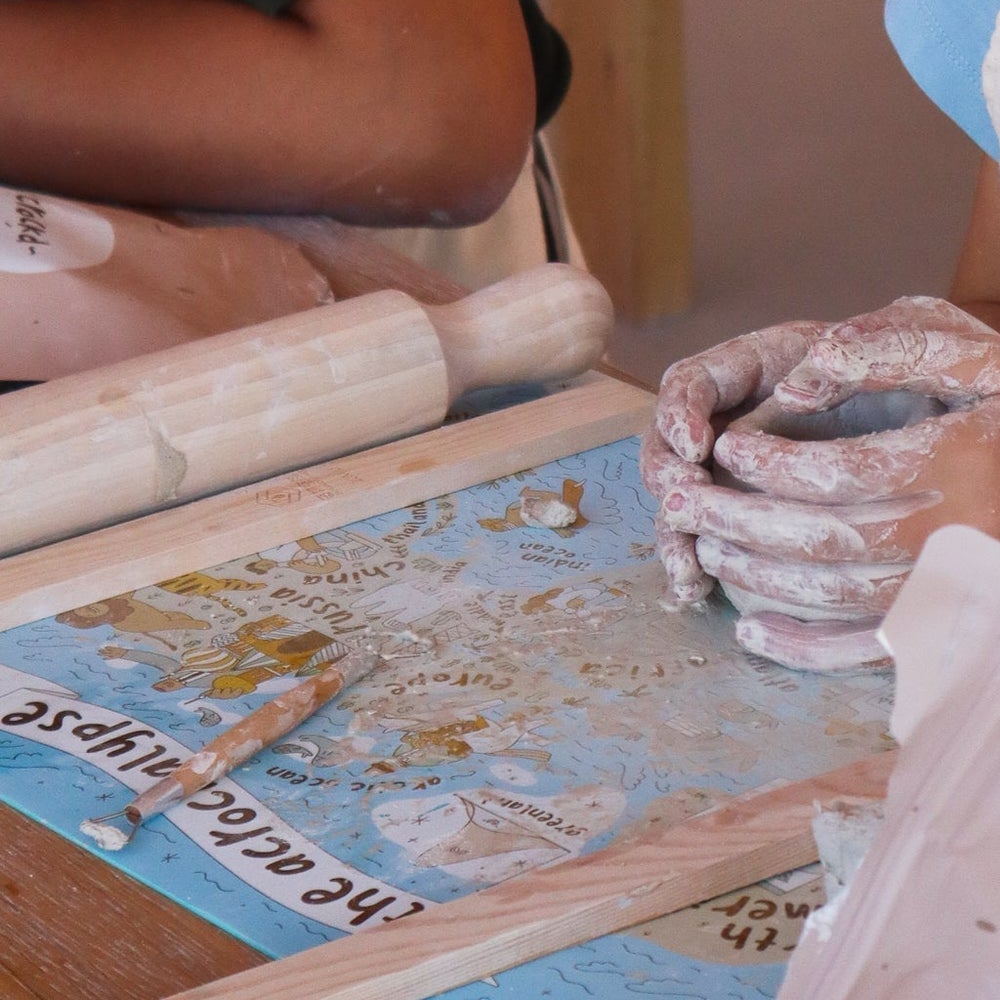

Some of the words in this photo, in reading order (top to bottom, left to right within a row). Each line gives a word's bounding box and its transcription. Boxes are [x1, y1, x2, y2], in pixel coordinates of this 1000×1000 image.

[519, 542, 576, 559] ocean
[303, 561, 406, 586] china
[521, 553, 590, 572] indian
[270, 588, 368, 635] russia
